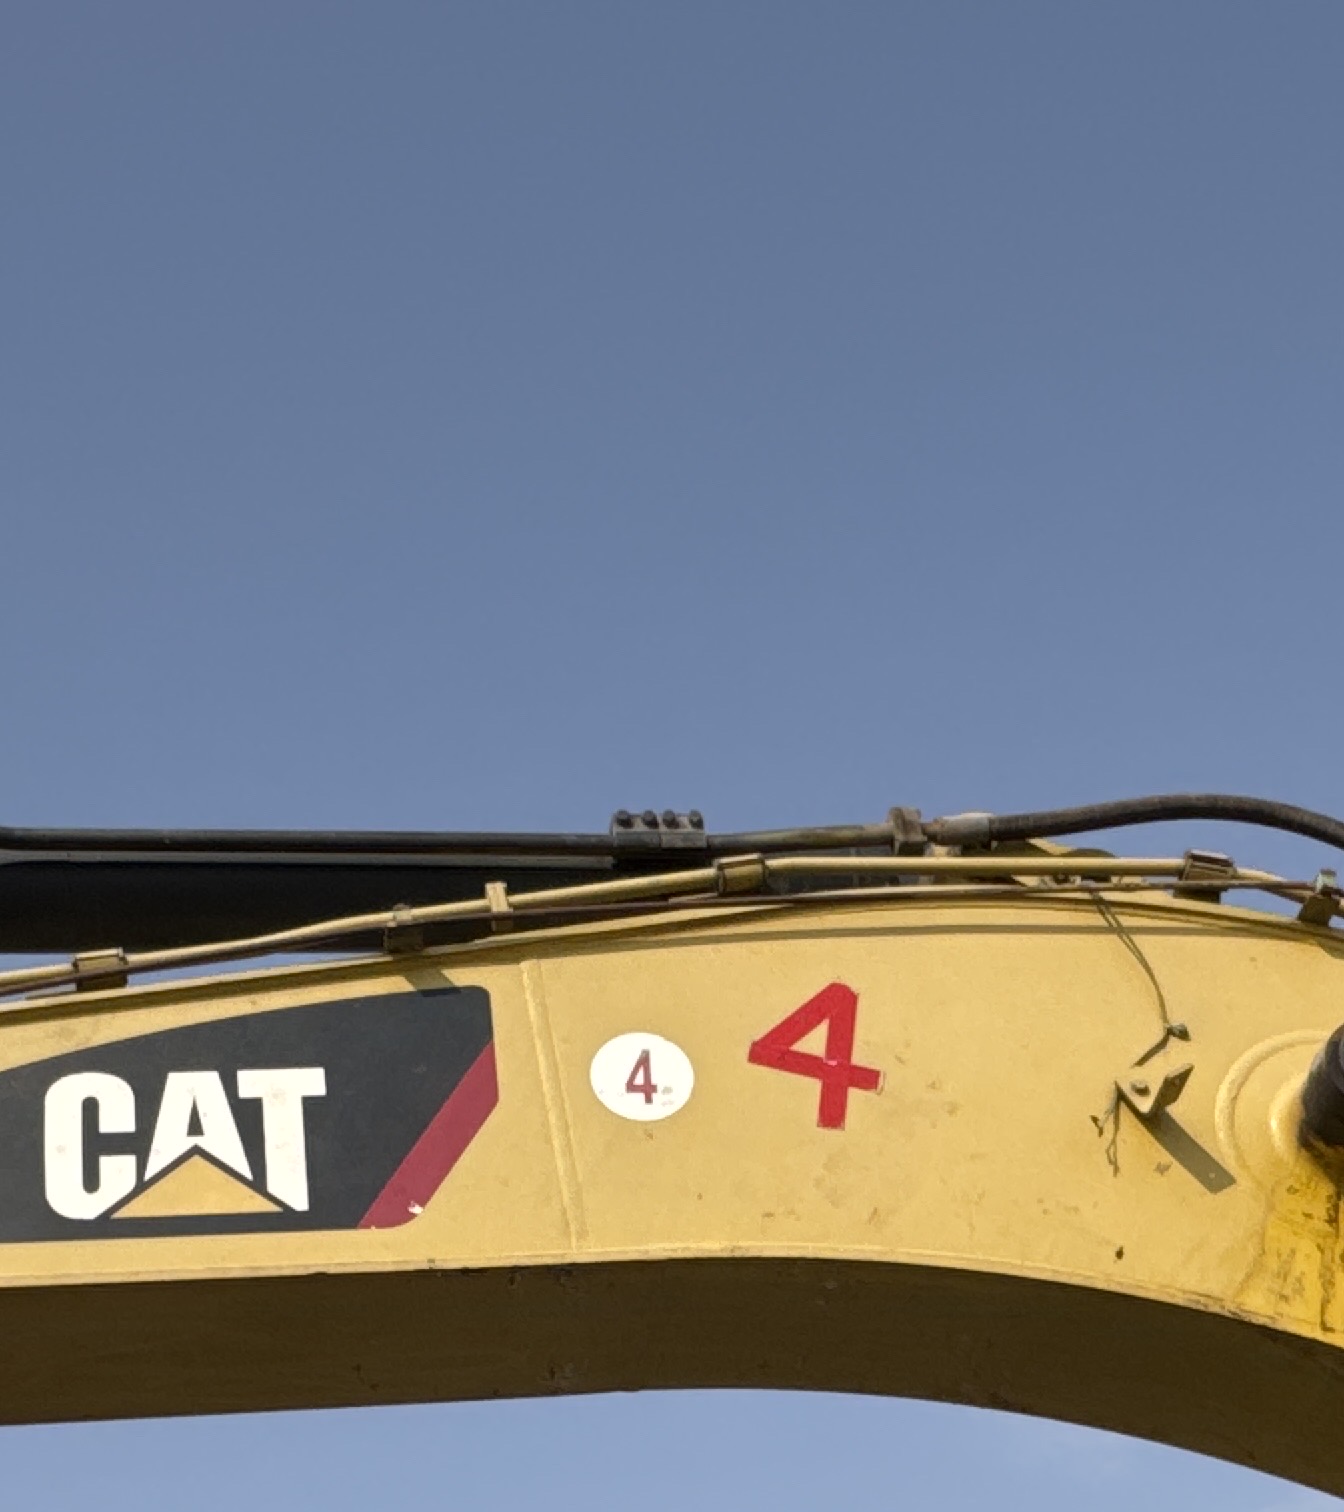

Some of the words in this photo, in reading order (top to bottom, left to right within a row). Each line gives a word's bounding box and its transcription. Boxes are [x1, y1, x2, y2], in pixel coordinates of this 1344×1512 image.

[624, 1048, 657, 1105] 4
[747, 981, 884, 1131] 4
[43, 1066, 327, 1220] CAT
